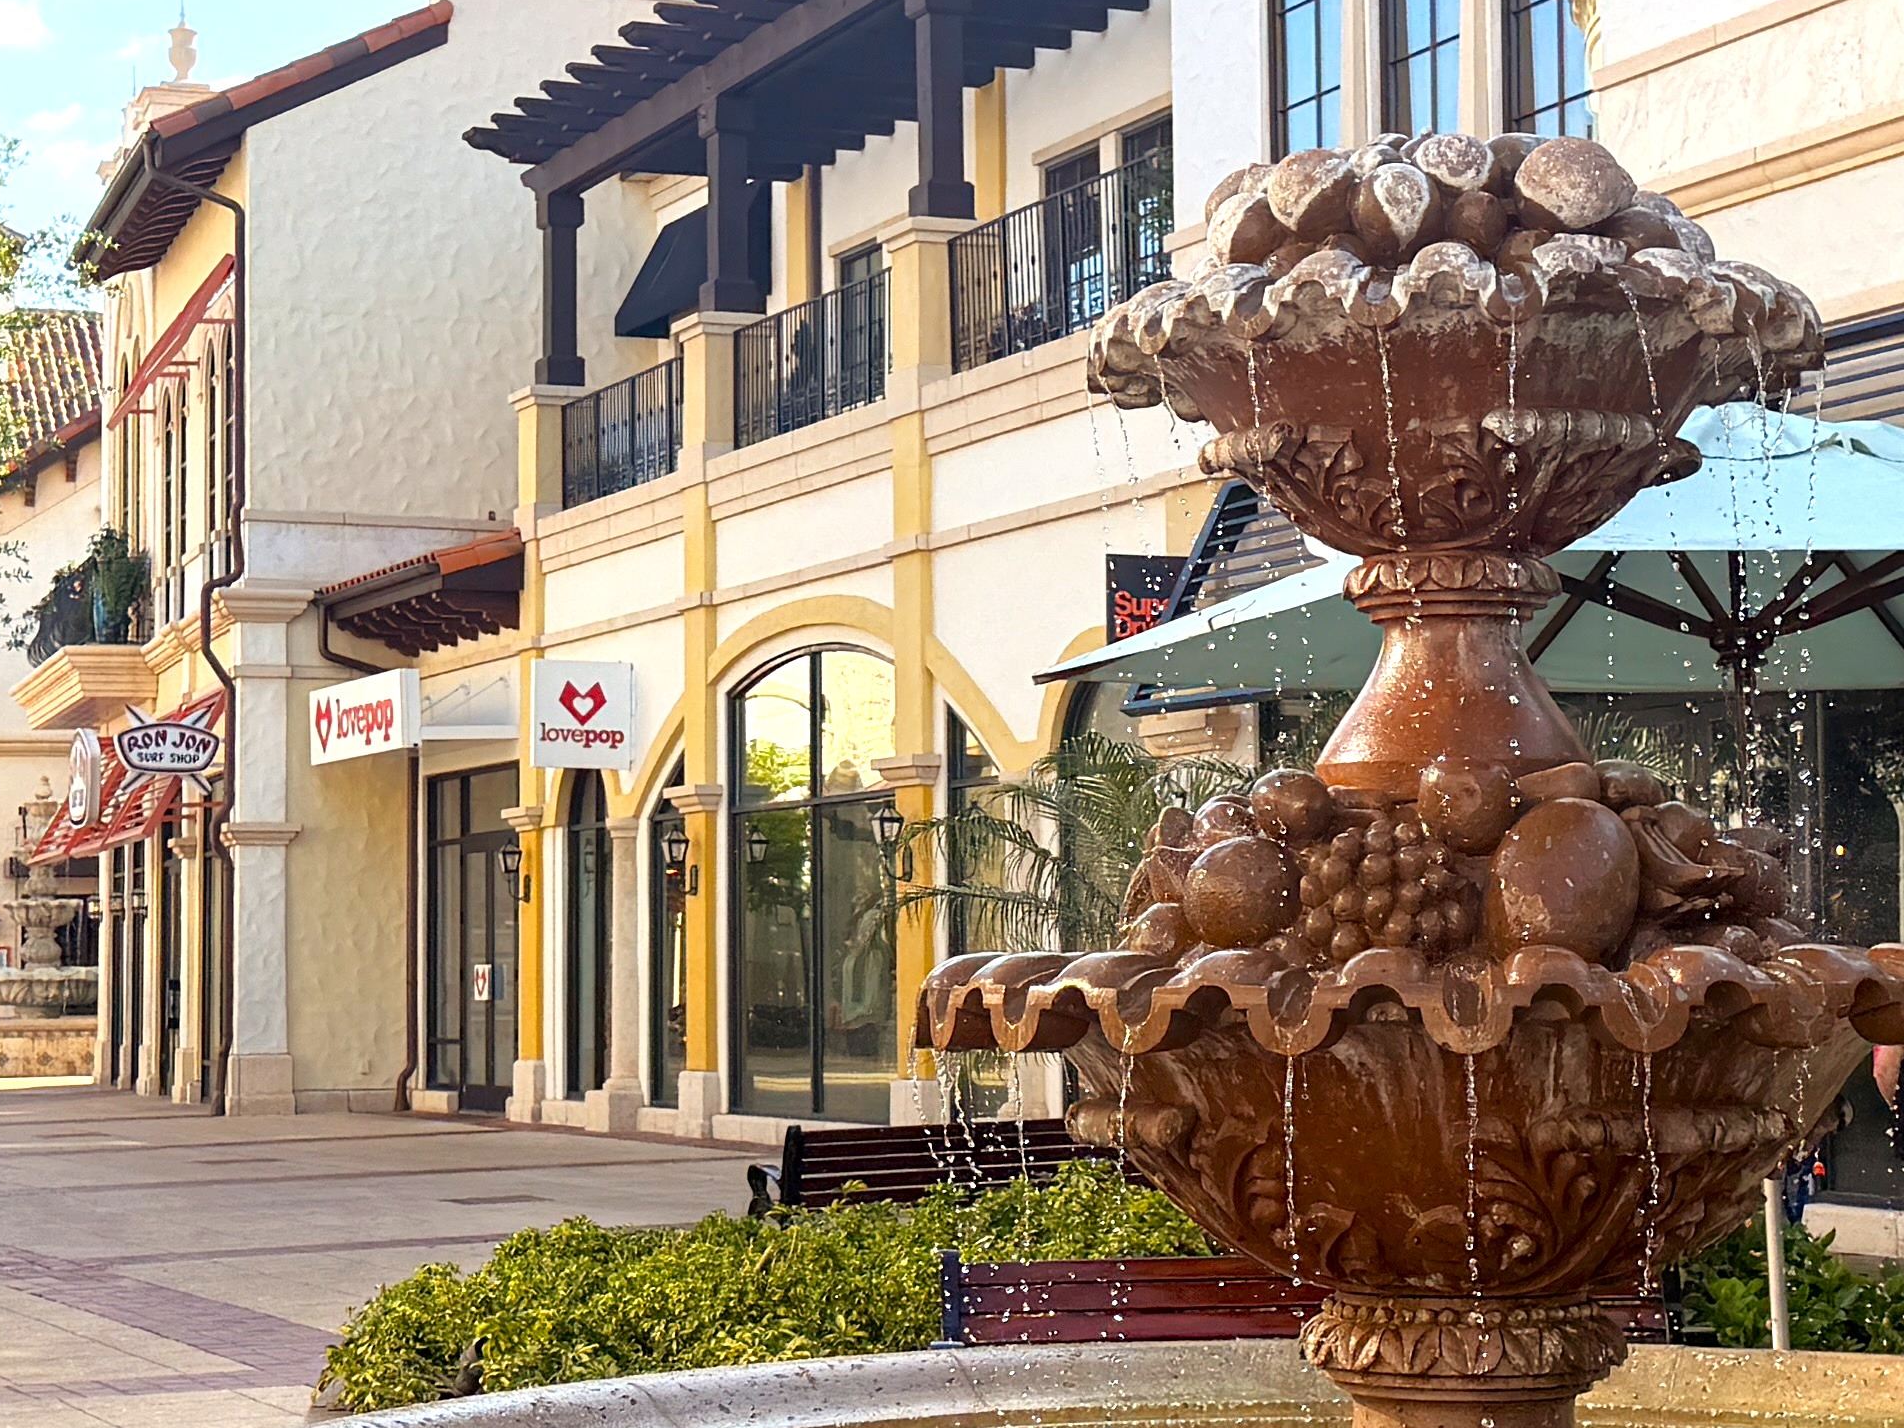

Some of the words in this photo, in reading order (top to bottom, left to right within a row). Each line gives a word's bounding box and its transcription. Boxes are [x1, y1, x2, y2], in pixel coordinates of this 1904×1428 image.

[336, 698, 394, 746] lovepop
[127, 729, 167, 753] RON
[171, 731, 211, 754] JON
[539, 722, 625, 749] lovepop
[136, 752, 165, 763] SURF
[169, 752, 200, 764] SHOP
